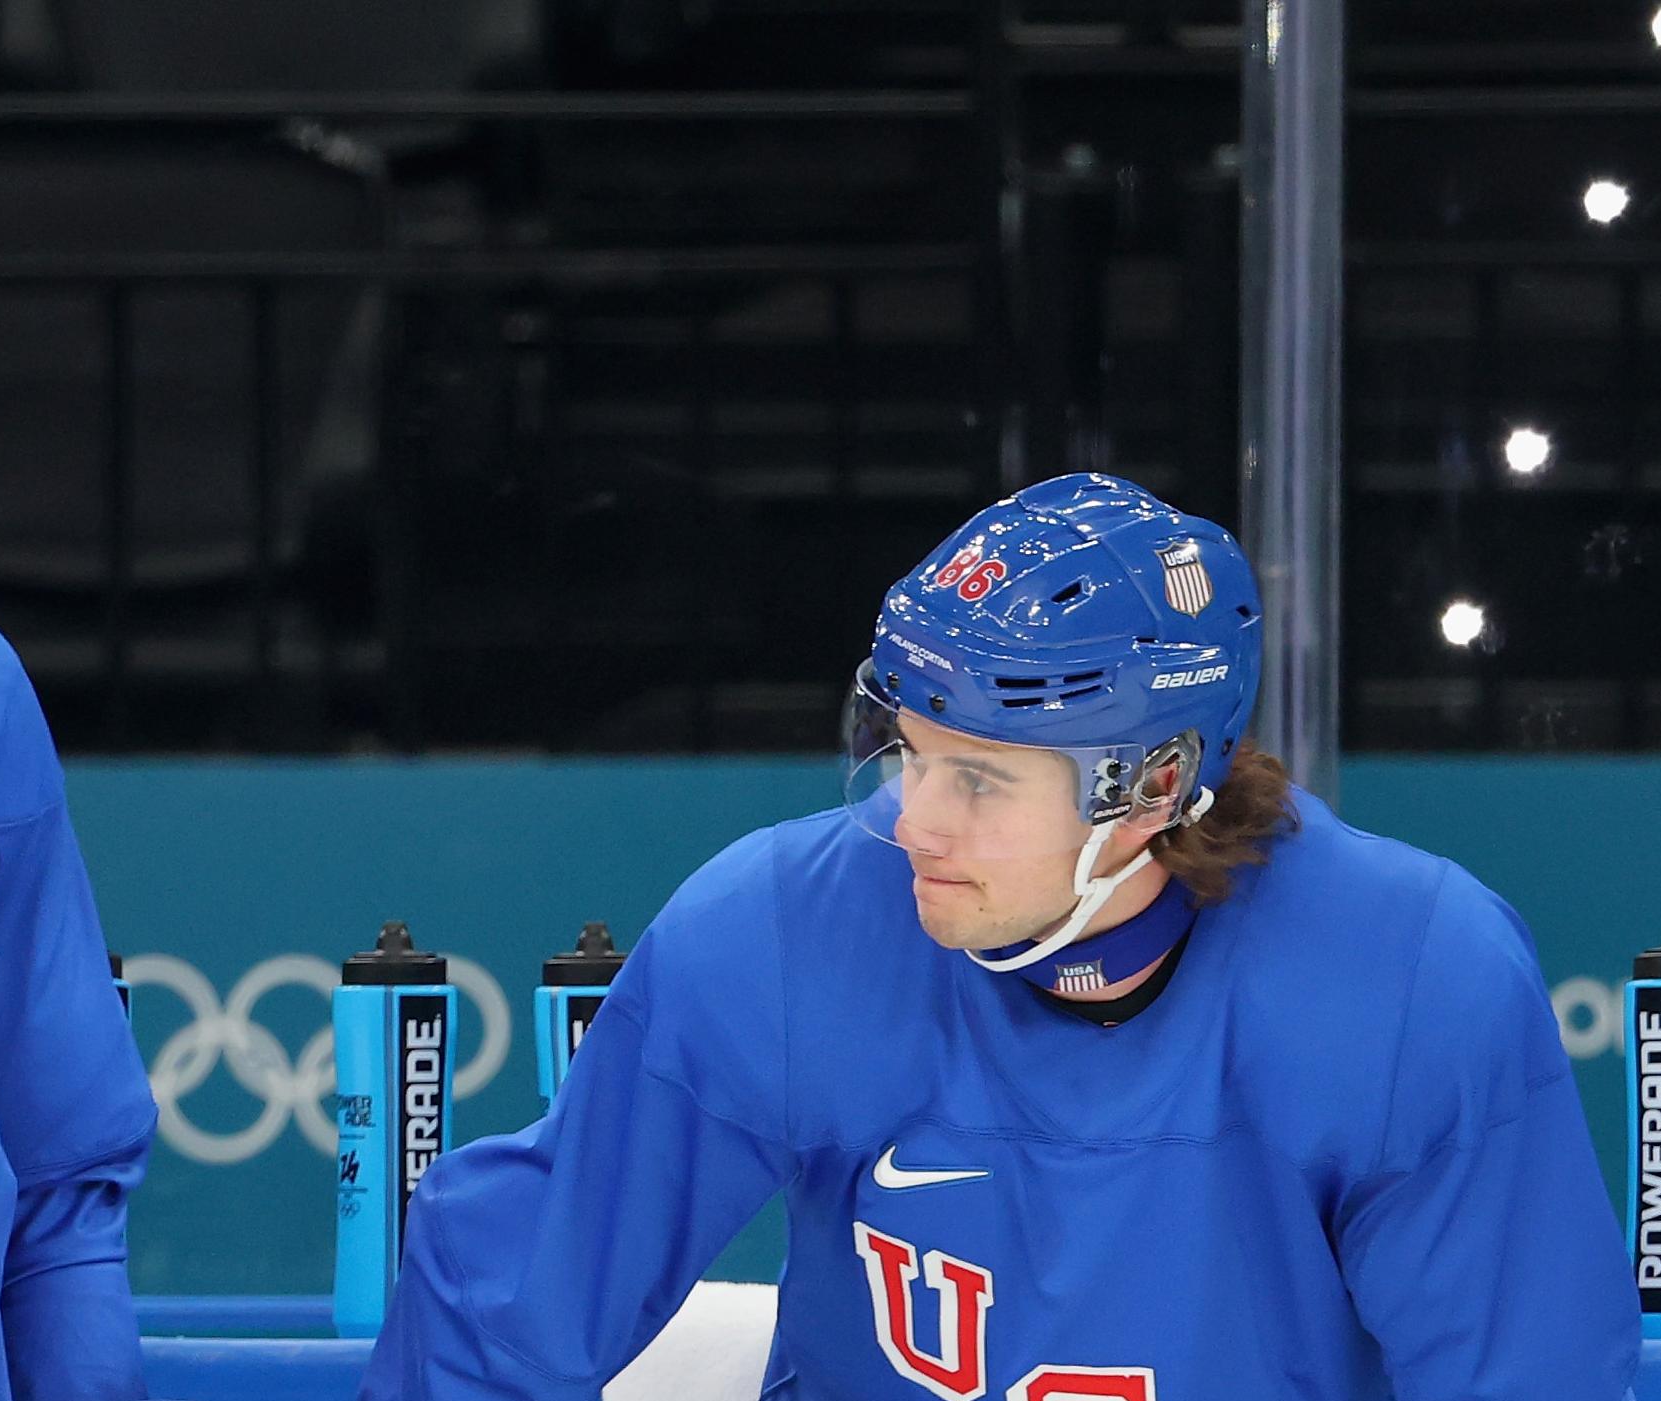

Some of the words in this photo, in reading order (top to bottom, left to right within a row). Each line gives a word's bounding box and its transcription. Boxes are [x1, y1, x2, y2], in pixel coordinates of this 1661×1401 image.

[936, 545, 1007, 602] 86
[888, 633, 919, 654] MILANO
[918, 647, 955, 673] CORTINA
[1063, 964, 1095, 976] USA
[406, 1017, 441, 1192] ERADE
